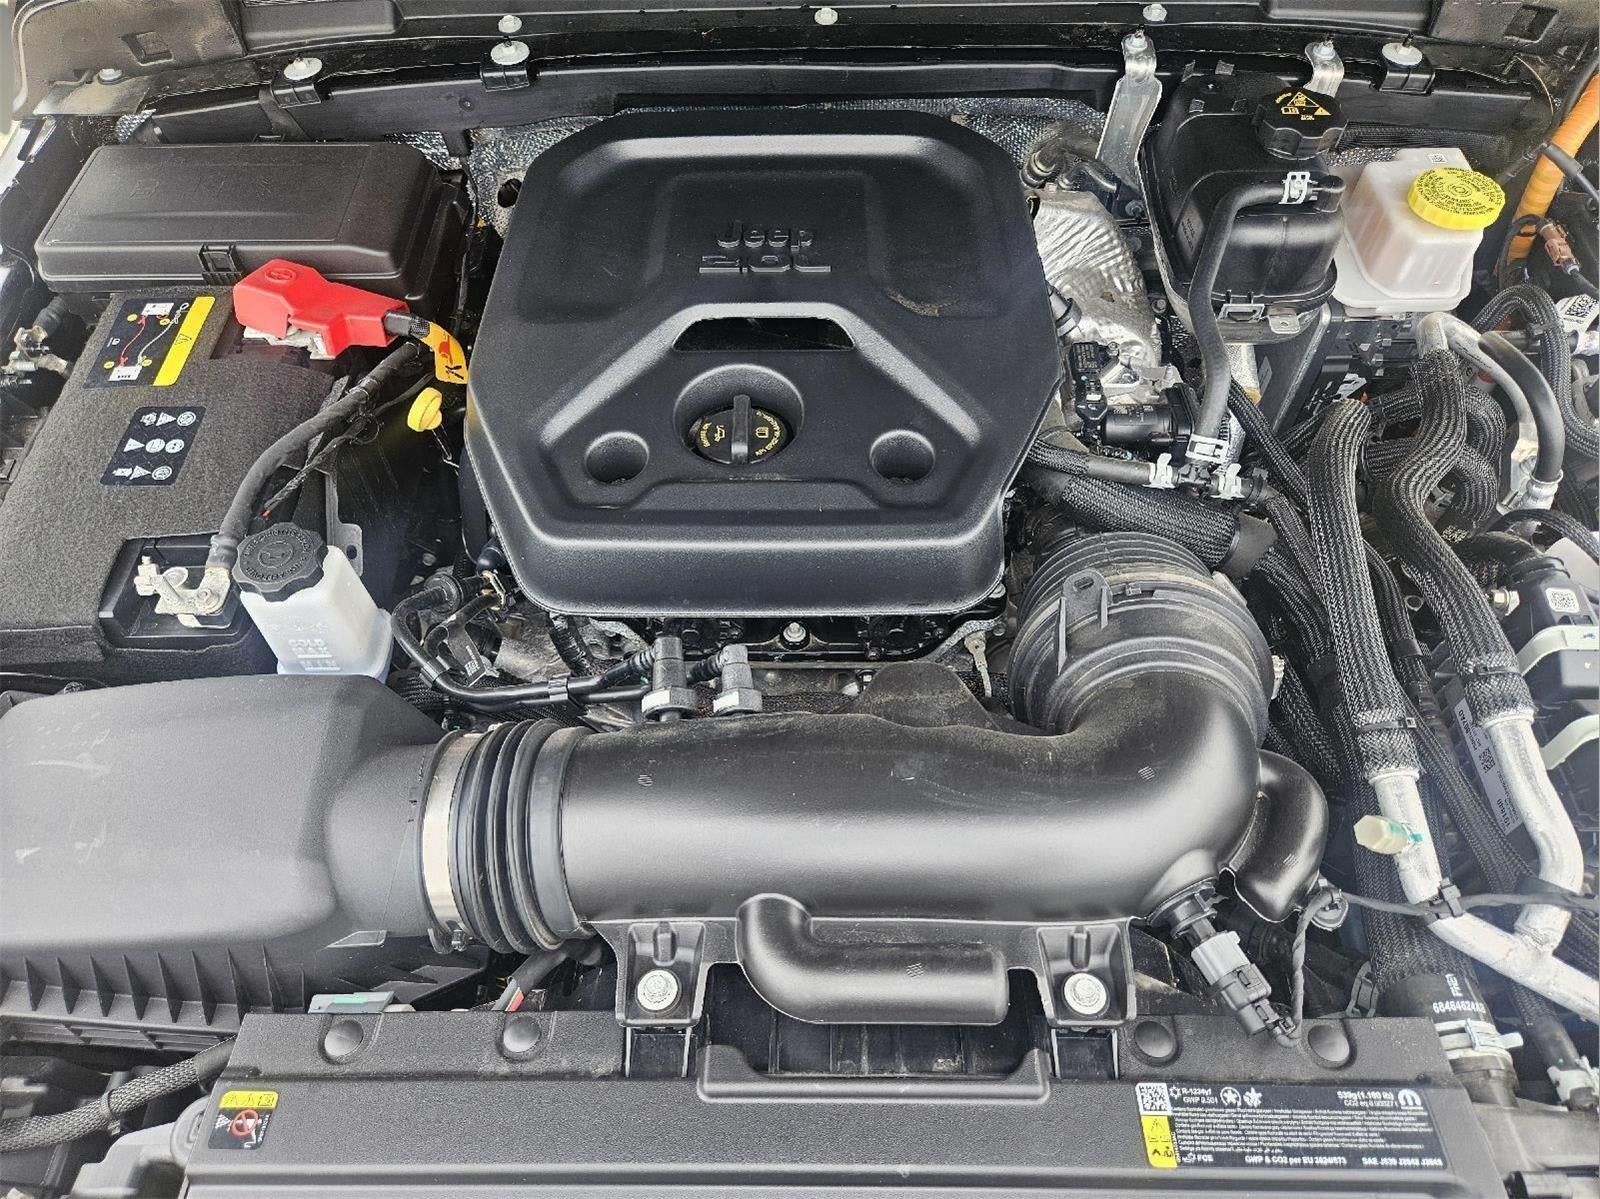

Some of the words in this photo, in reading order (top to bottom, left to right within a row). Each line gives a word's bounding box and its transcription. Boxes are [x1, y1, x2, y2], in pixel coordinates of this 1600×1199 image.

[714, 219, 813, 253] Jeep
[698, 254, 831, 273] 2.0L
[287, 638, 325, 648] COLD
[1182, 1096, 1200, 1104] GWP
[1244, 1155, 1264, 1164] GWP
[1271, 1156, 1288, 1165] CO2
[1288, 1157, 1302, 1166] per
[1301, 1156, 1314, 1165] EU
[1361, 1157, 1379, 1166] SAE
